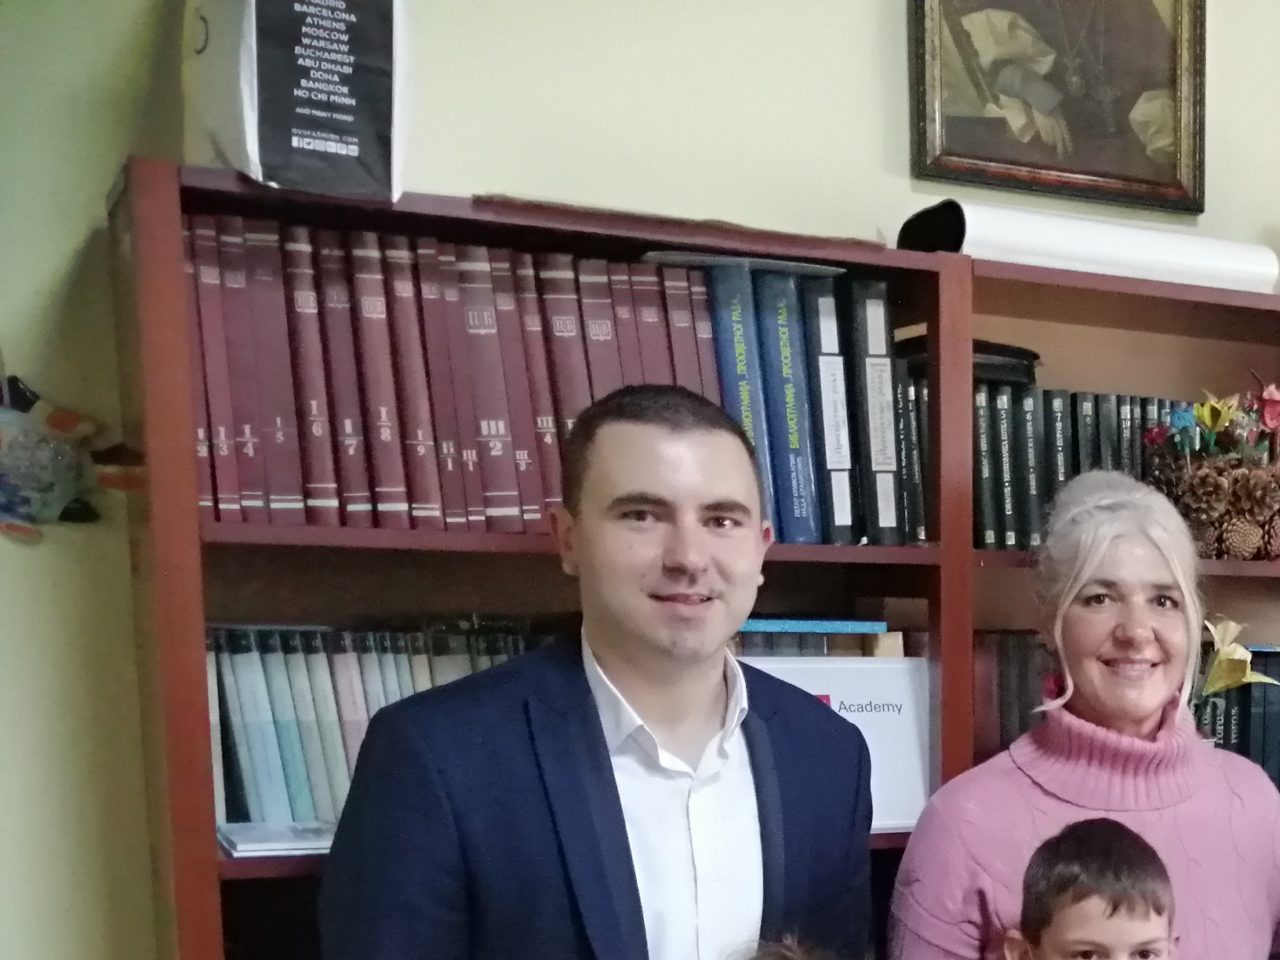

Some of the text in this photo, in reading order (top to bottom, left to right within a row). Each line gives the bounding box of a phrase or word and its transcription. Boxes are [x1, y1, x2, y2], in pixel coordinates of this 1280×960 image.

[294, 3, 357, 22] BARCELONA
[305, 16, 346, 31] ATHENS
[301, 26, 349, 42] MOSCOW
[301, 37, 350, 53] WARSAW
[294, 46, 356, 63] BUCHAREST
[297, 58, 353, 74] ABU DHABI
[310, 70, 340, 82] DOHA
[300, 79, 350, 94] BANGKOK
[294, 88, 357, 106] HO CHI MINH
[312, 421, 322, 437] 6
[380, 427, 391, 442] 8
[243, 442, 254, 457] 4
[344, 440, 357, 455] 7
[489, 440, 503, 456] 2
[838, 700, 903, 715] Academy
